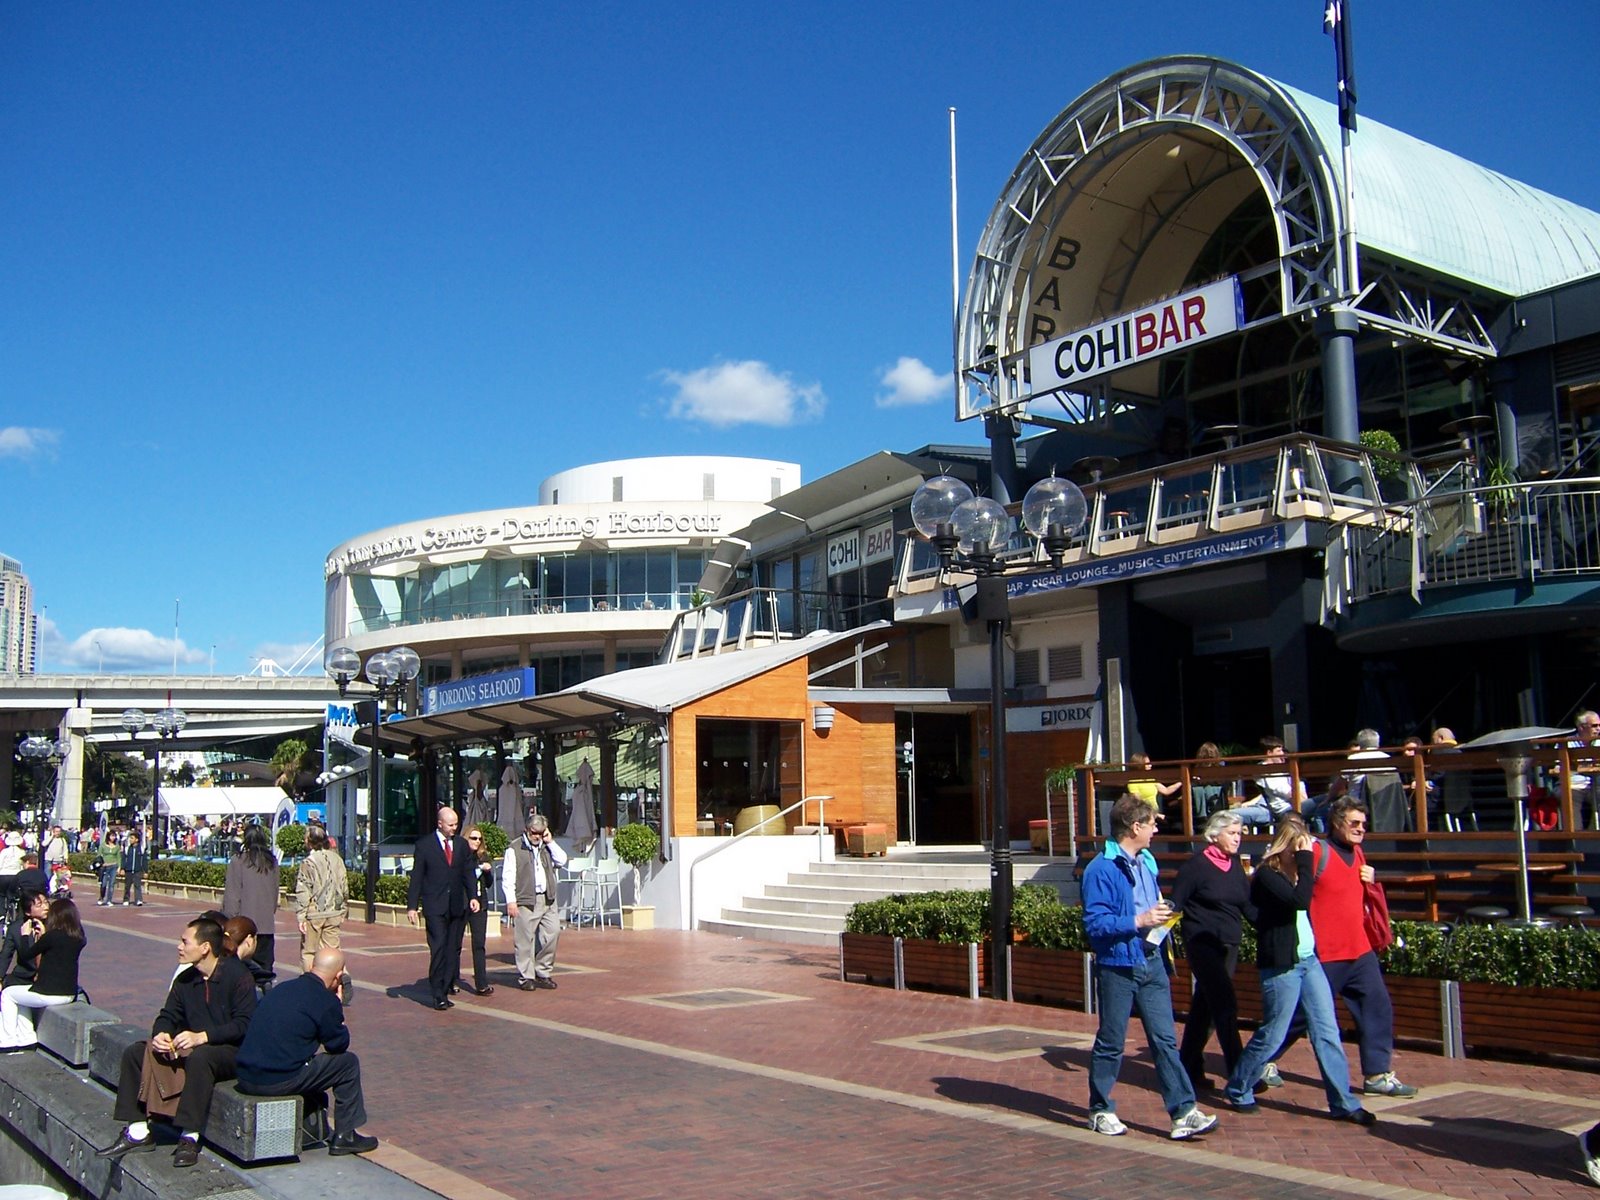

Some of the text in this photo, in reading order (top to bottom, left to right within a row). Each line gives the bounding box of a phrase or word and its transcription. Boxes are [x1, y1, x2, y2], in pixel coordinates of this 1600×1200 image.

[1030, 236, 1081, 345] BAR
[421, 523, 487, 551] Centre
[502, 514, 599, 540] Darling
[609, 511, 721, 534] Harbour
[829, 528, 892, 567] COHI BAR
[1032, 575, 1063, 588] CIGAR
[1065, 565, 1108, 582] LOUNGE
[1118, 558, 1154, 572] MUSIC
[1164, 535, 1266, 563] ENTERTAINMENT
[439, 677, 521, 706] JORDONS SEAFOOD
